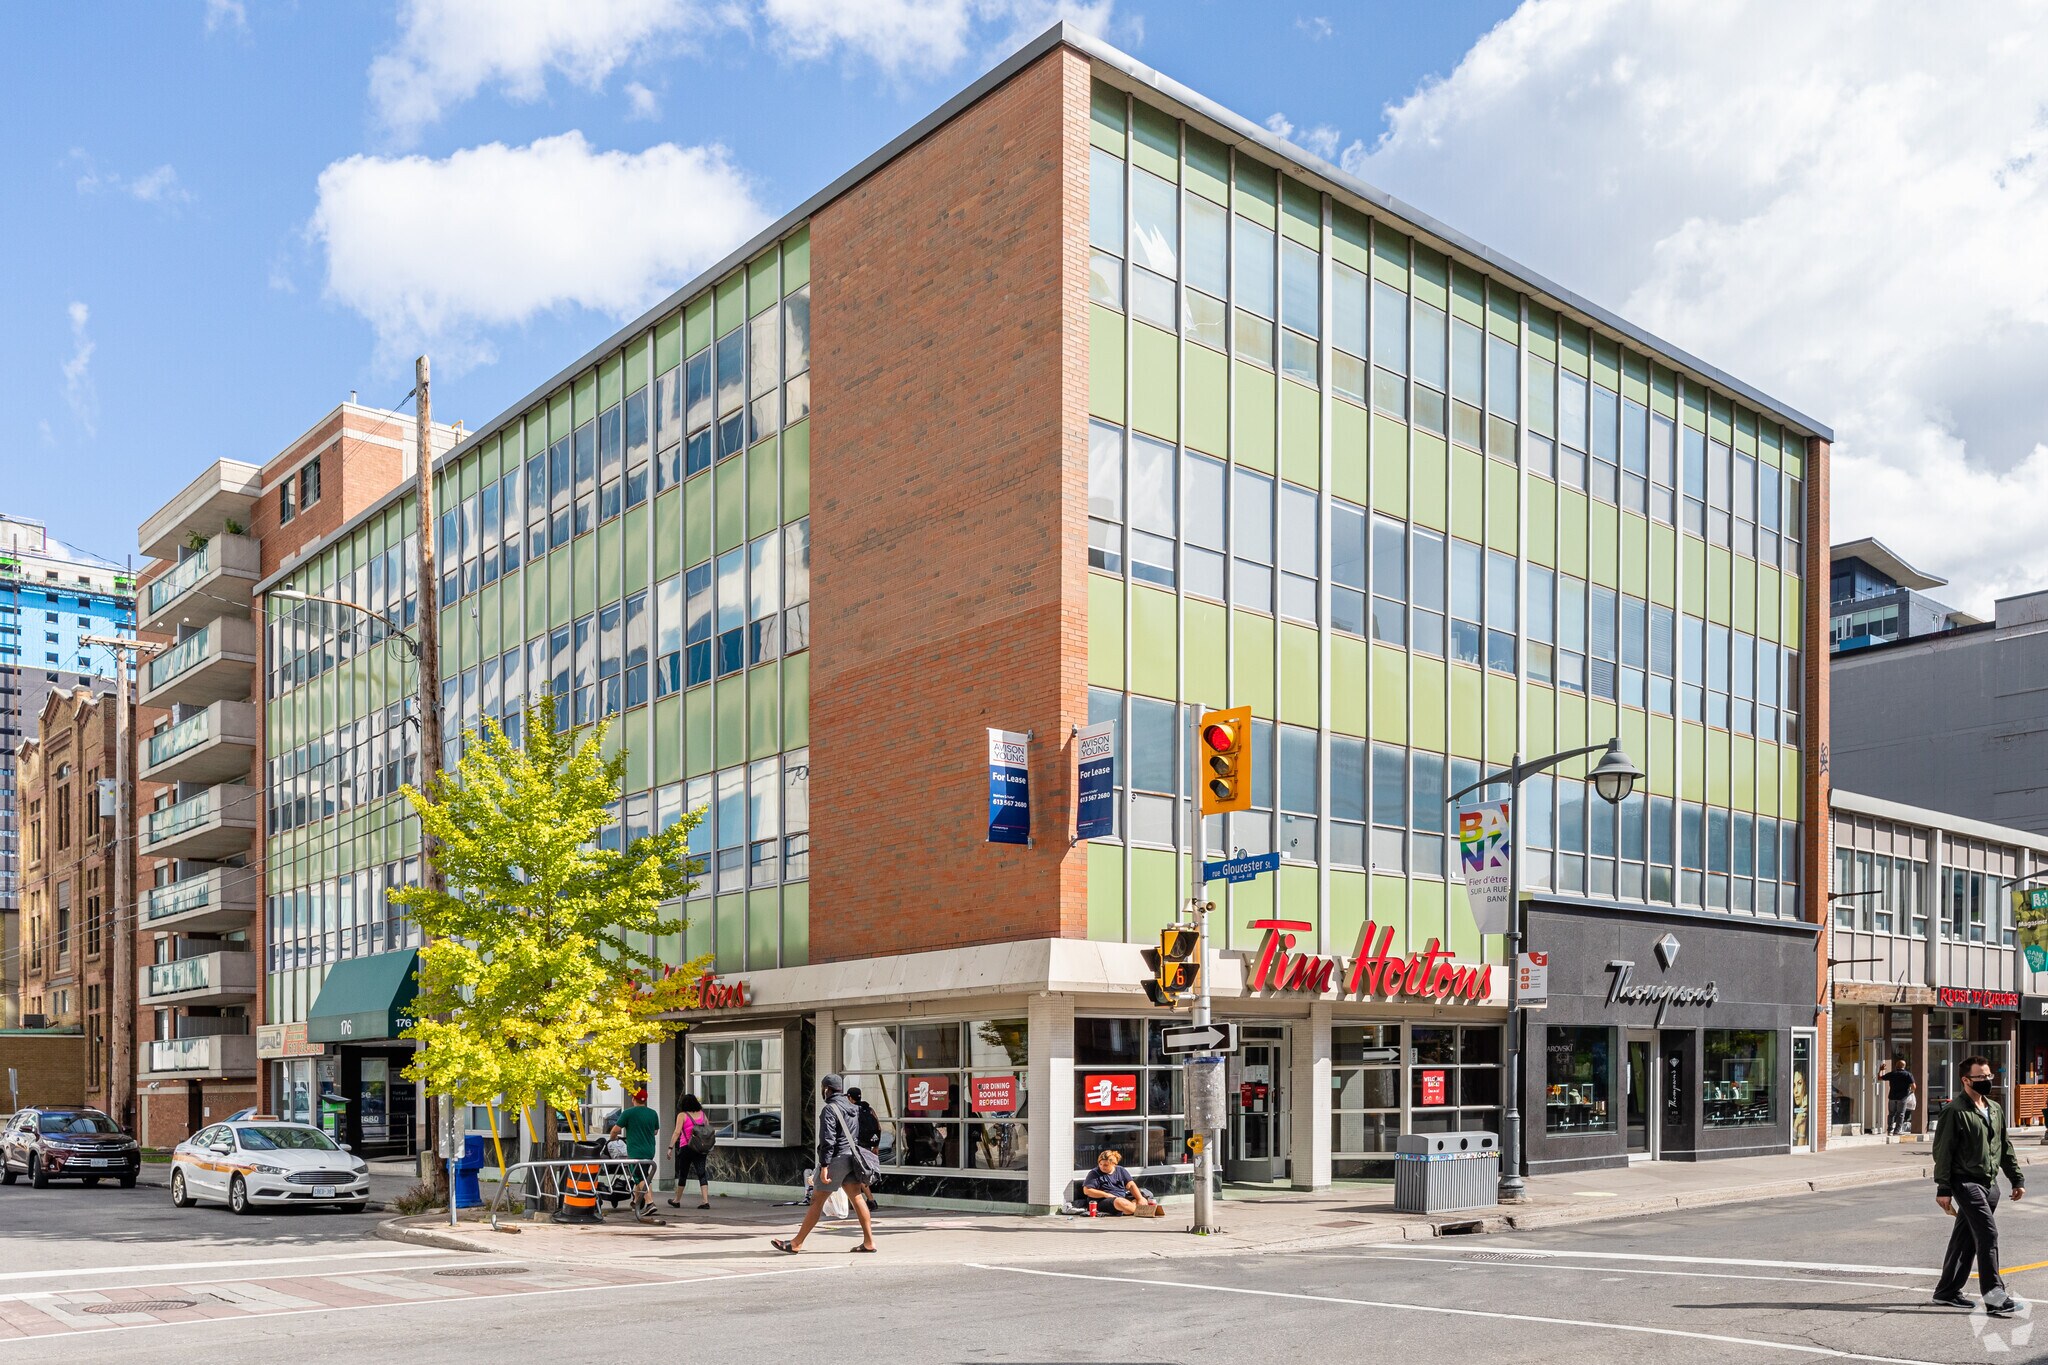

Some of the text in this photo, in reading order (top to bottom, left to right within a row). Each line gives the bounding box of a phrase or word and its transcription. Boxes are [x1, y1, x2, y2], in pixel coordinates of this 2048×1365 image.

[1081, 735, 1110, 749] AVISON
[994, 743, 1025, 755] AVISON
[1081, 744, 1110, 757] YOUNG
[994, 751, 1025, 763] YOUNG
[993, 771, 1026, 785] For Lease
[1080, 766, 1111, 780] For Lease
[1080, 796, 1088, 804] 613
[1088, 793, 1097, 801] 567
[1098, 791, 1111, 800] 2680
[1014, 801, 1028, 809] 2680
[1212, 860, 1273, 878] rue Gloucester St.
[1468, 876, 1508, 887] Fier d'être
[1493, 885, 1508, 893] RUE
[1487, 895, 1508, 903] BANK
[1247, 919, 1492, 1000] Tim Hortons
[1176, 967, 1184, 985] 6
[1610, 960, 1720, 1025] Thompson's
[341, 1020, 352, 1035] 176
[396, 1018, 412, 1028] 176
[979, 1089, 1009, 1098] ROOM HAS
[978, 1098, 1010, 1106] REOPENED!
